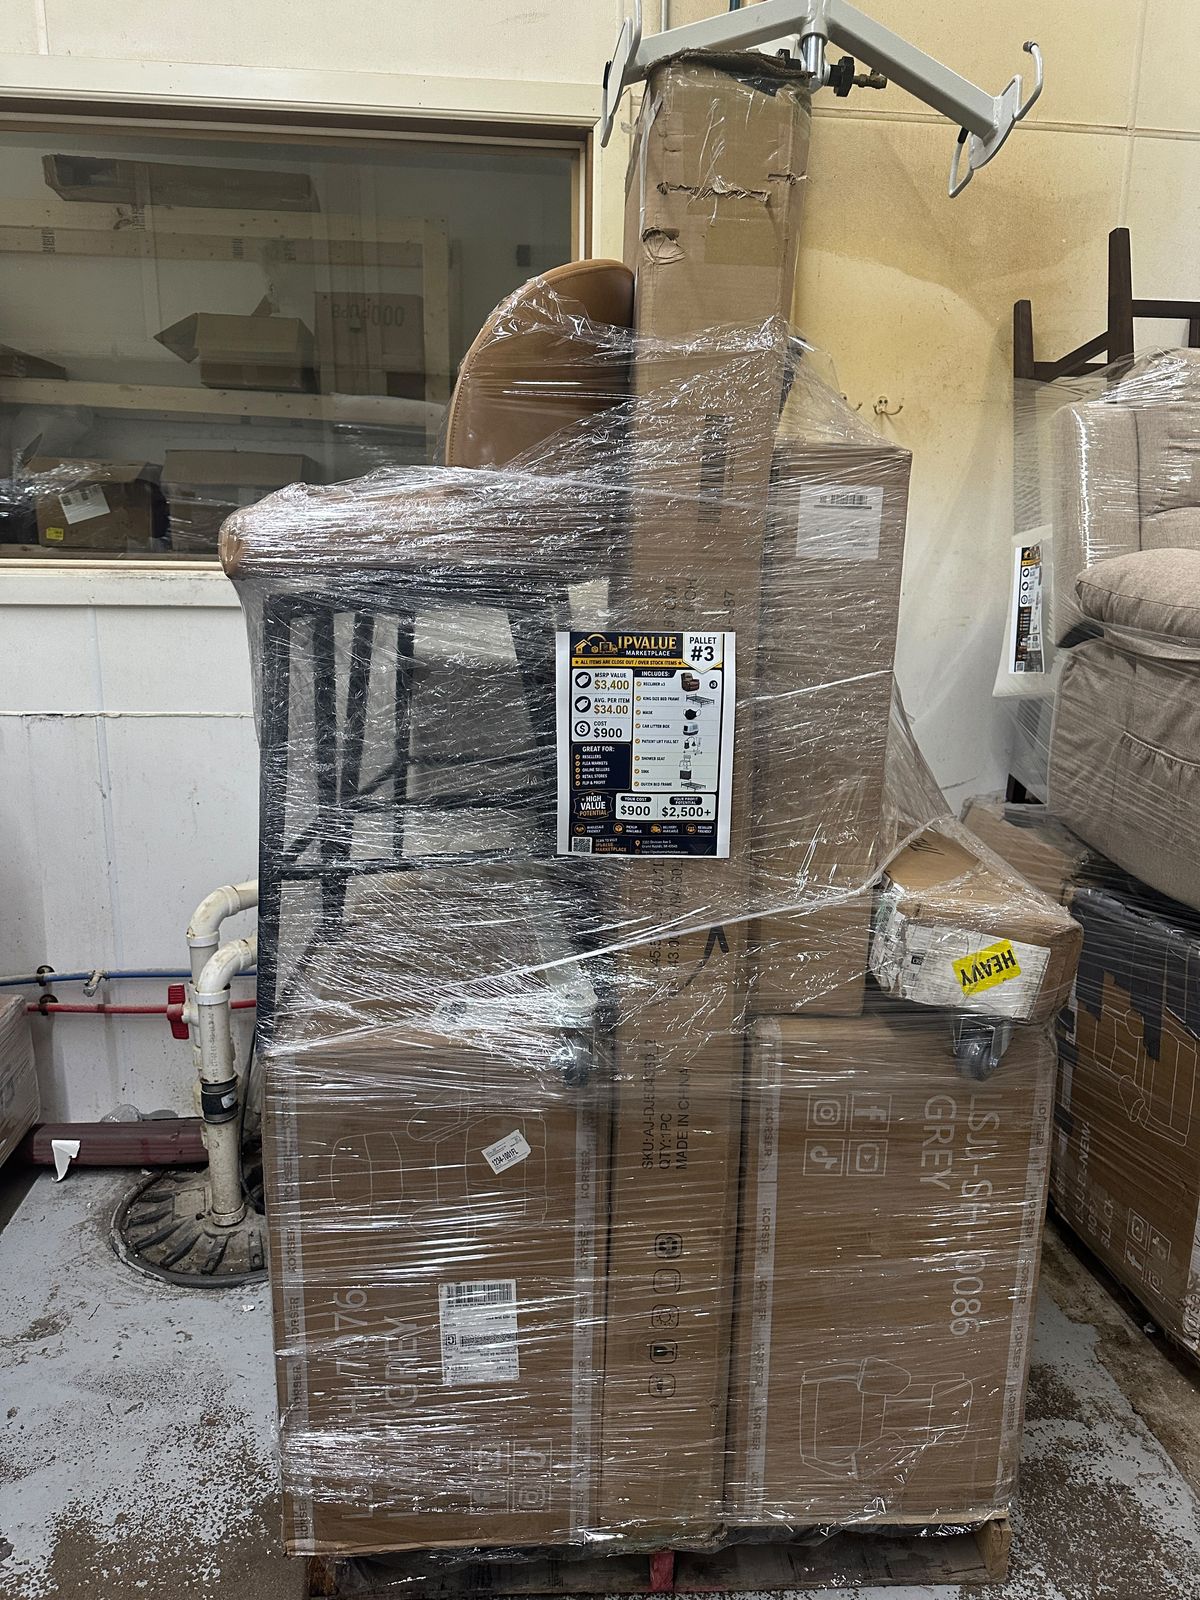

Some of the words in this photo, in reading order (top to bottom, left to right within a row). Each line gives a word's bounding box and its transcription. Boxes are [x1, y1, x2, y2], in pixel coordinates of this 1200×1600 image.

[618, 636, 677, 650] IPVALUE
[690, 646, 715, 662] #3
[594, 680, 630, 691] $3,400
[594, 704, 628, 714] $34.00
[594, 728, 623, 738] $900
[580, 802, 606, 810] VALUE
[620, 805, 650, 816] $900
[662, 806, 712, 819] $2,500+
[961, 950, 1016, 987] HEAVY
[678, 1114, 689, 1127] IN
[658, 1112, 672, 1170] QTY:1PC
[920, 1094, 958, 1191] GREY
[676, 1130, 689, 1170] MADE
